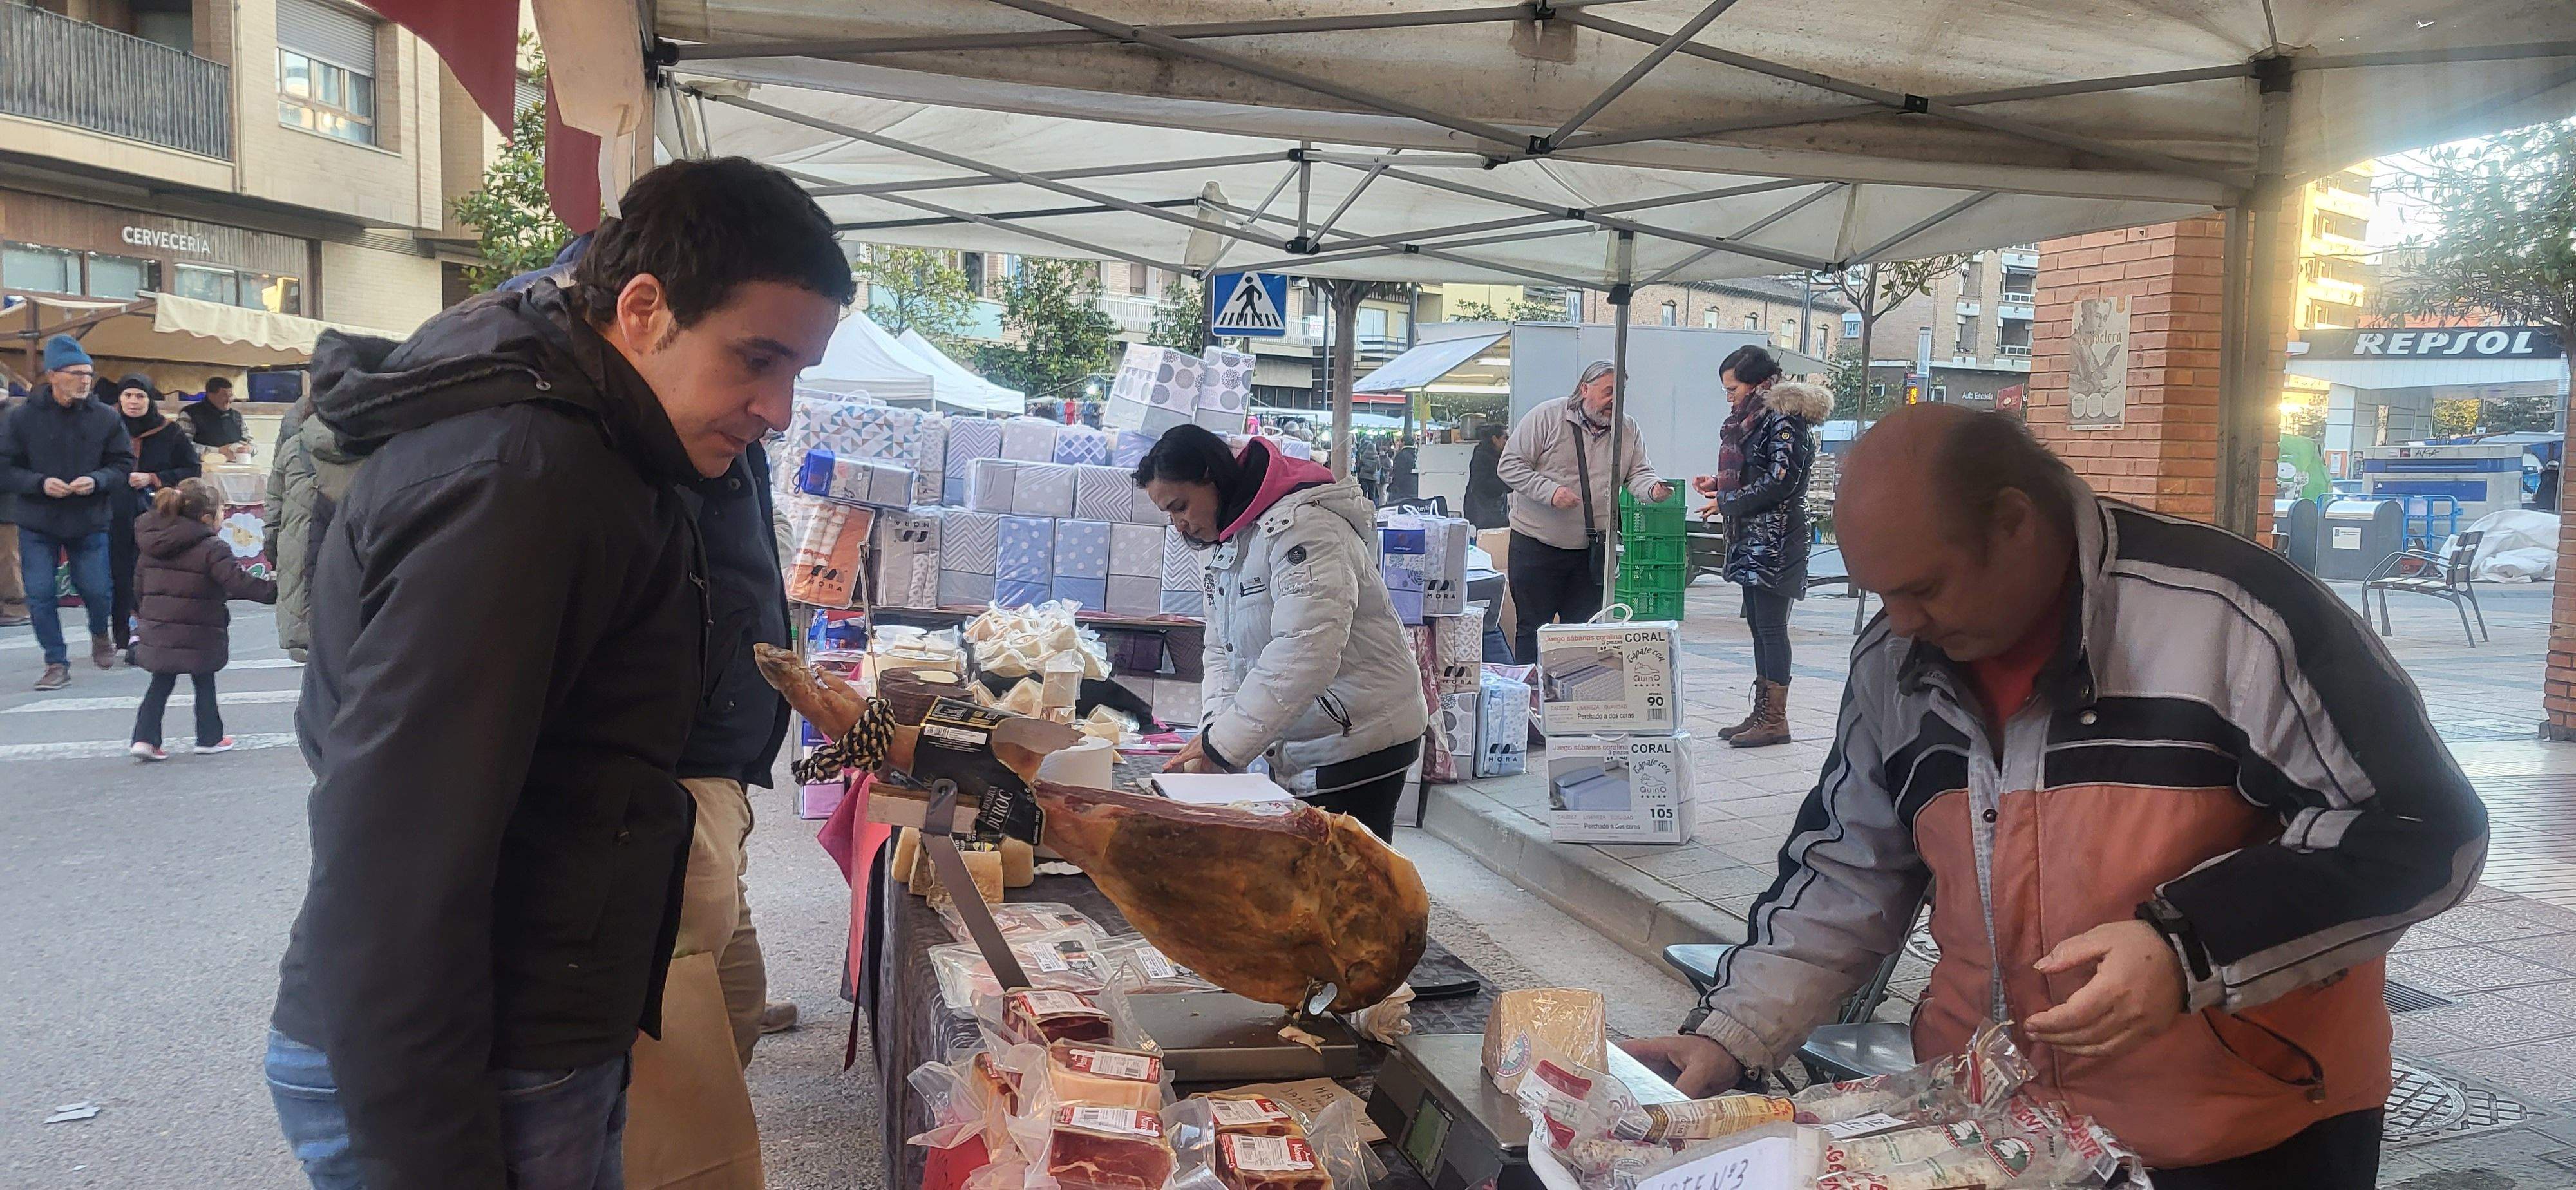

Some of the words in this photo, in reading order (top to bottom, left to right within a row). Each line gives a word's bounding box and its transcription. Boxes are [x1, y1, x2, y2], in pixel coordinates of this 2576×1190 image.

[122, 226, 211, 254] CERVECERÍA
[2353, 330, 2533, 355] REPSOL
[1962, 391, 1974, 400] Auto
[1975, 392, 1994, 401] Escuela
[896, 520, 929, 528] MORA
[808, 579, 842, 592] MORA
[1427, 592, 1456, 600] MORA
[1625, 632, 1665, 643] CORAL
[1647, 696, 1664, 706] 90
[1631, 744, 1671, 753] CORAL
[1488, 755, 1517, 764] MORA
[987, 789, 1014, 831] DUROC
[1650, 808, 1673, 818] 105
